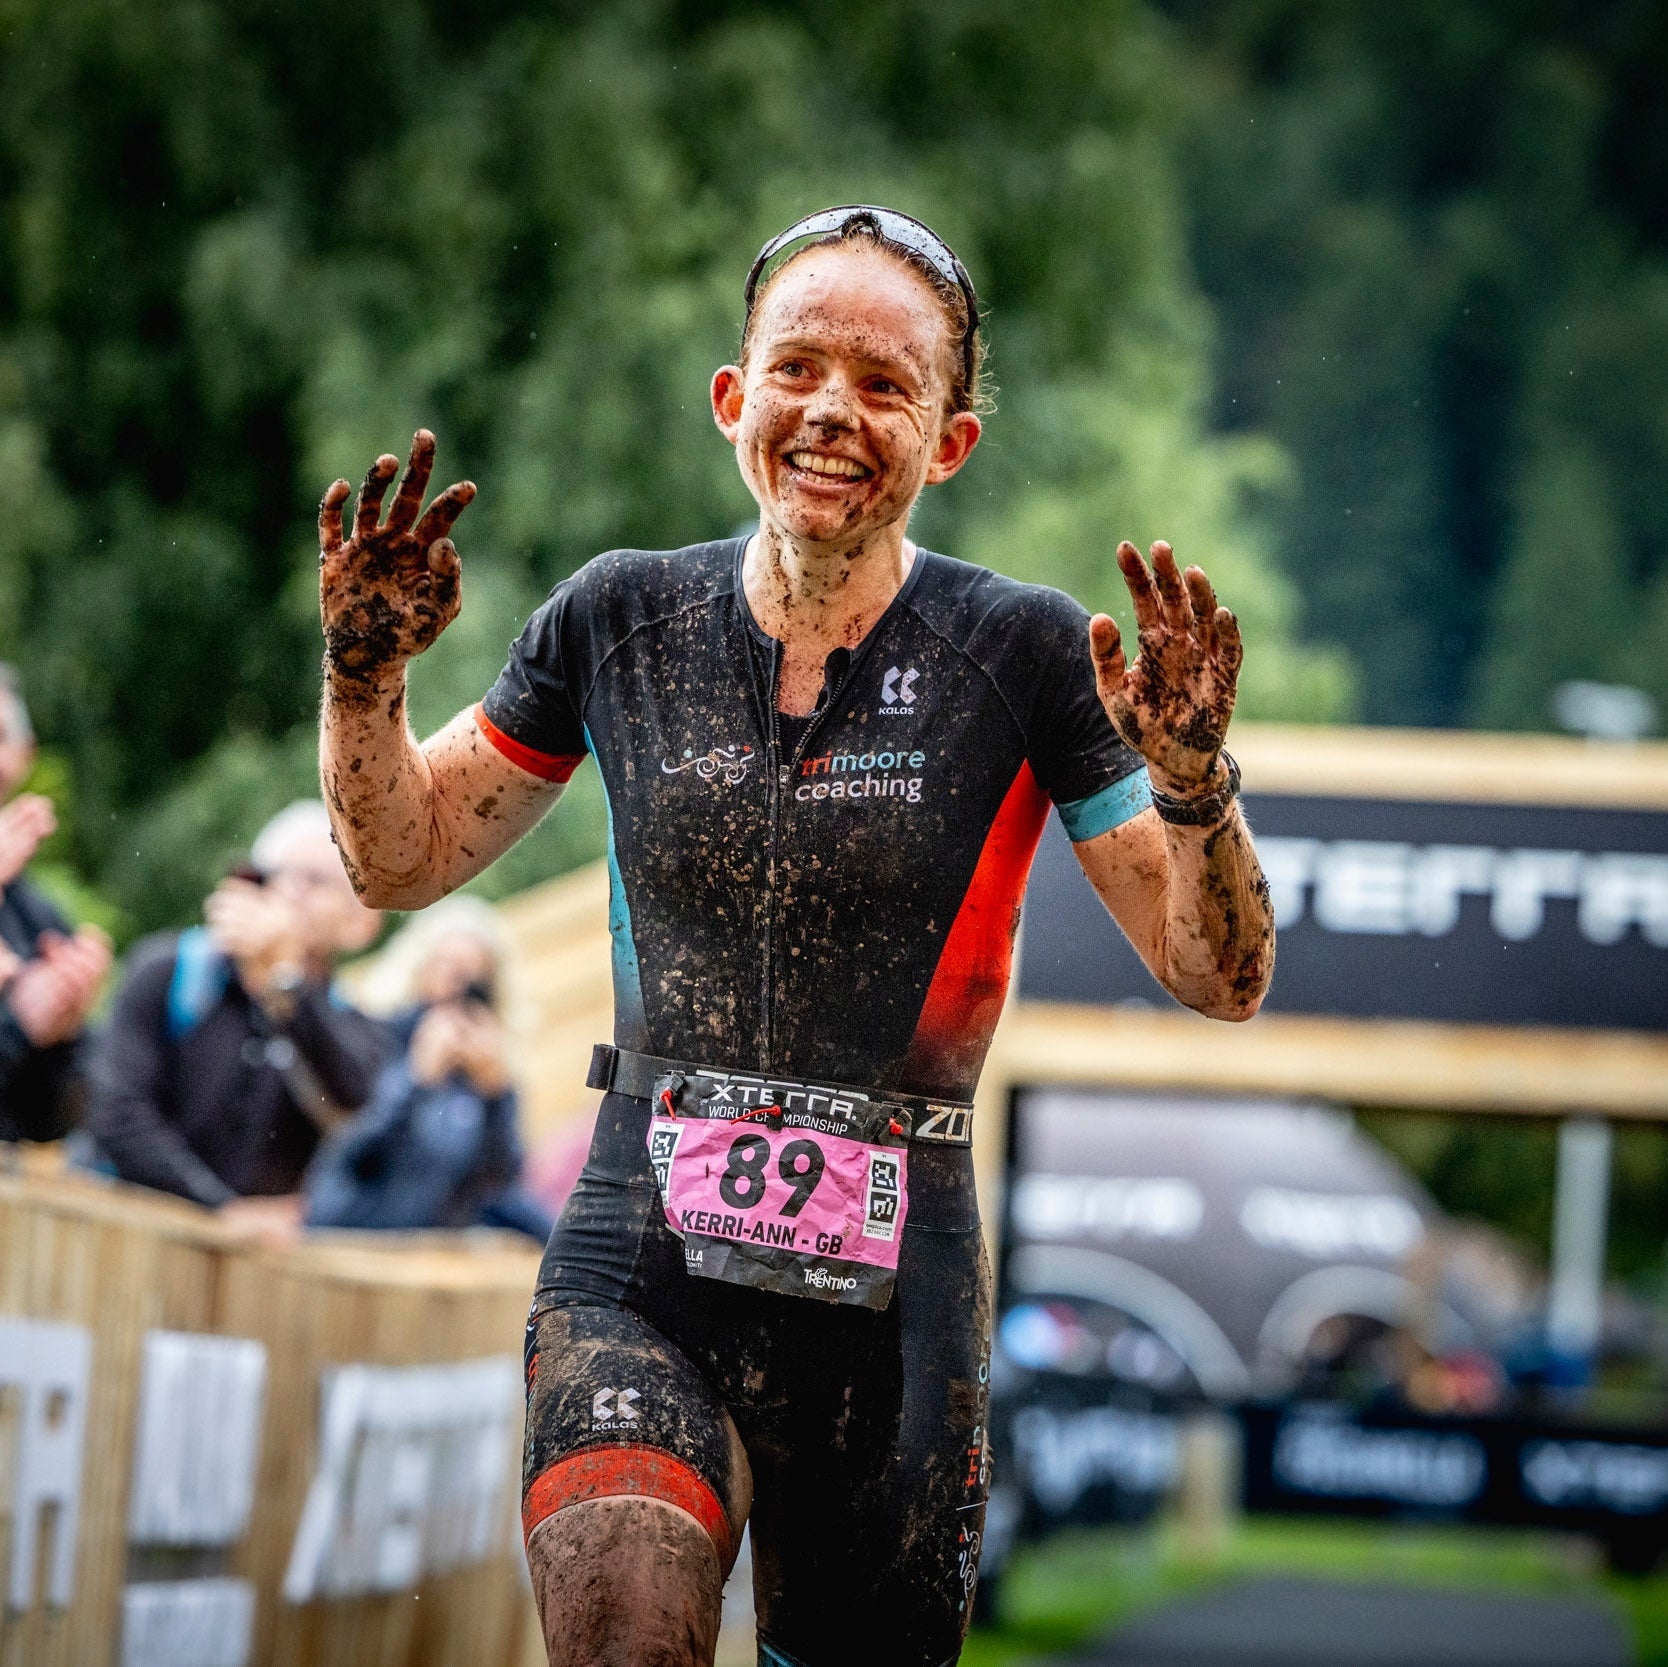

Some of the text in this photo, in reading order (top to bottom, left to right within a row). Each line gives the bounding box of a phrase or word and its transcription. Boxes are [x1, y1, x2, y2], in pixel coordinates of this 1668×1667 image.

[801, 749, 926, 776] trimoore
[795, 773, 924, 803] coaching
[709, 1105, 848, 1135] WORLD CHMPIONSHIP
[719, 1133, 825, 1218] 89
[681, 1209, 797, 1248] KERRI-ANN
[815, 1232, 844, 1255] GB
[803, 1268, 857, 1291] TRENTINO
